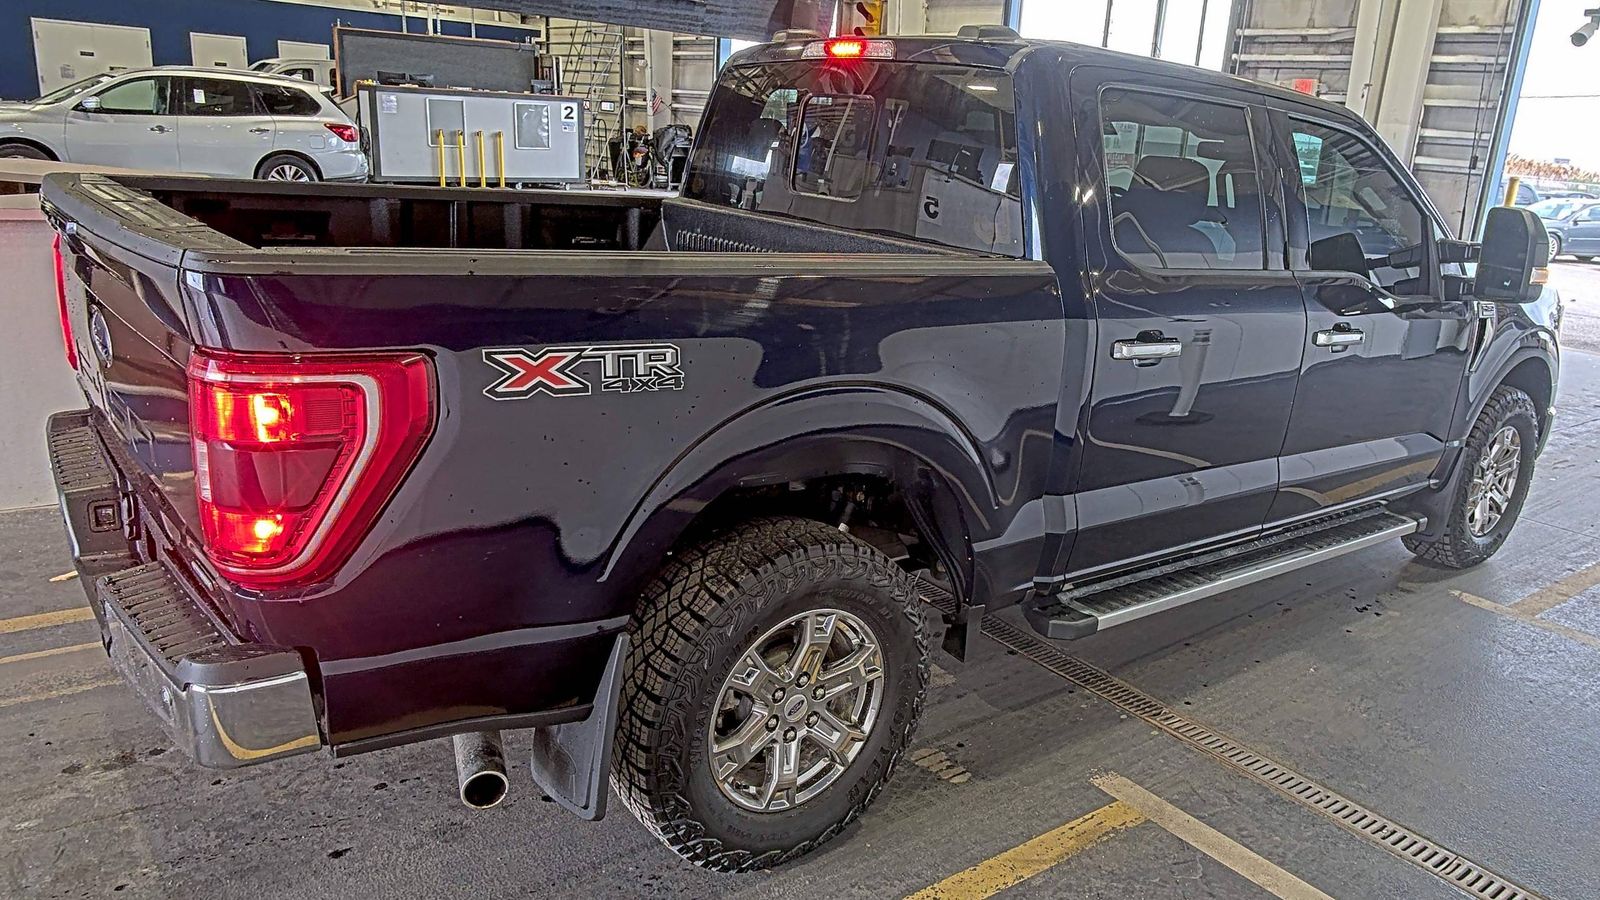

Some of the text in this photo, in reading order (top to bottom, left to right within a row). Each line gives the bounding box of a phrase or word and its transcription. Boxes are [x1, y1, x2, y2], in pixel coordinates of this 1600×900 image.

[563, 106, 575, 120] 2
[482, 343, 682, 400] XTR
[601, 375, 685, 394] 4x4
